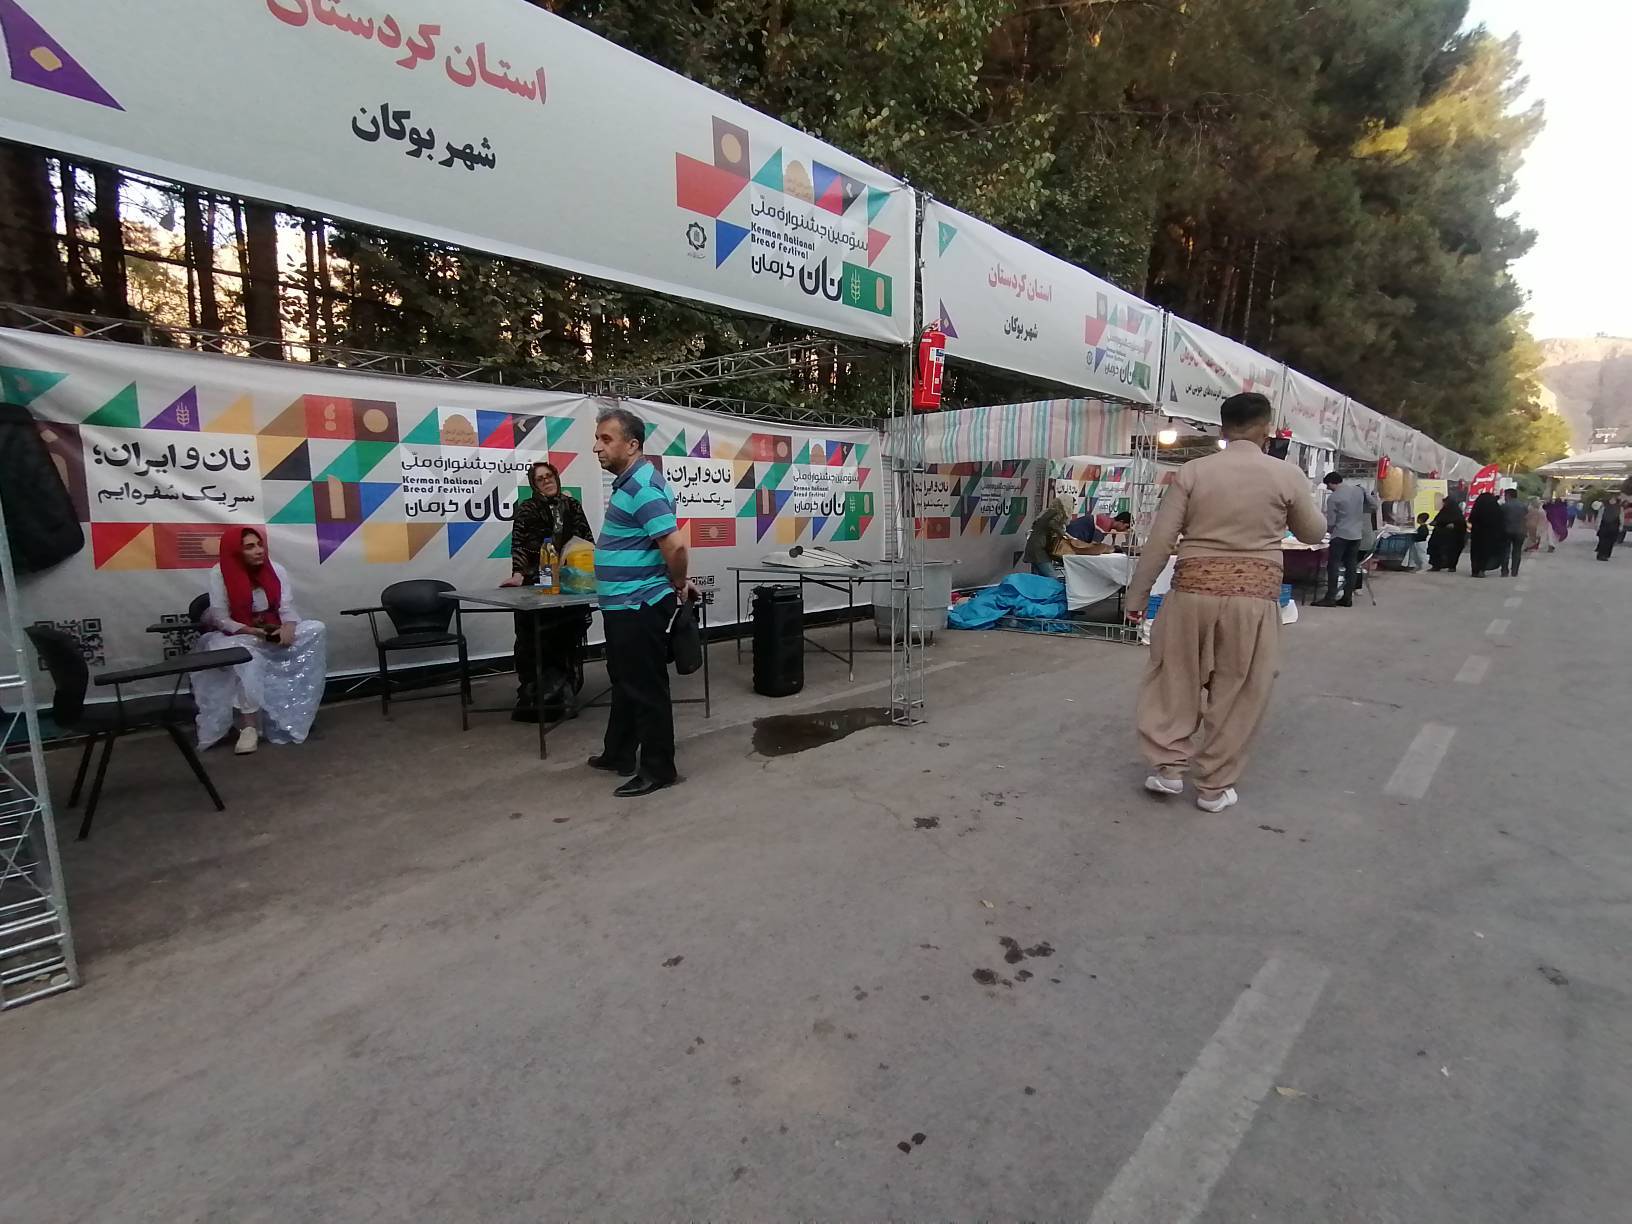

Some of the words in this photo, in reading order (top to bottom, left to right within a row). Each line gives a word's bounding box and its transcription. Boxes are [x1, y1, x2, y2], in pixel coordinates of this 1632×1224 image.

[445, 42, 547, 104] استان
[352, 102, 435, 161] بوکان
[438, 136, 496, 171] شهر
[751, 221, 781, 241] Kerman
[783, 233, 815, 252] National
[751, 234, 776, 249] Bread
[778, 243, 809, 260] Festival
[751, 253, 795, 281] کرمان
[799, 256, 843, 301] نان
[988, 262, 1027, 298] کردستان
[1027, 279, 1052, 302] استان
[1004, 315, 1024, 339] بوکان
[1023, 323, 1038, 341] شهر
[180, 446, 200, 470] و
[203, 447, 251, 472] نان
[402, 476, 440, 485] Kerman
[443, 477, 483, 486] National
[702, 467, 711, 483] و
[711, 467, 731, 483] نان
[181, 485, 226, 505] یک
[403, 485, 434, 494] Bread
[438, 486, 475, 494] Festival
[702, 492, 721, 505] یک
[405, 498, 459, 517] کرمان
[464, 485, 514, 522] نان
[820, 491, 846, 516] نان
